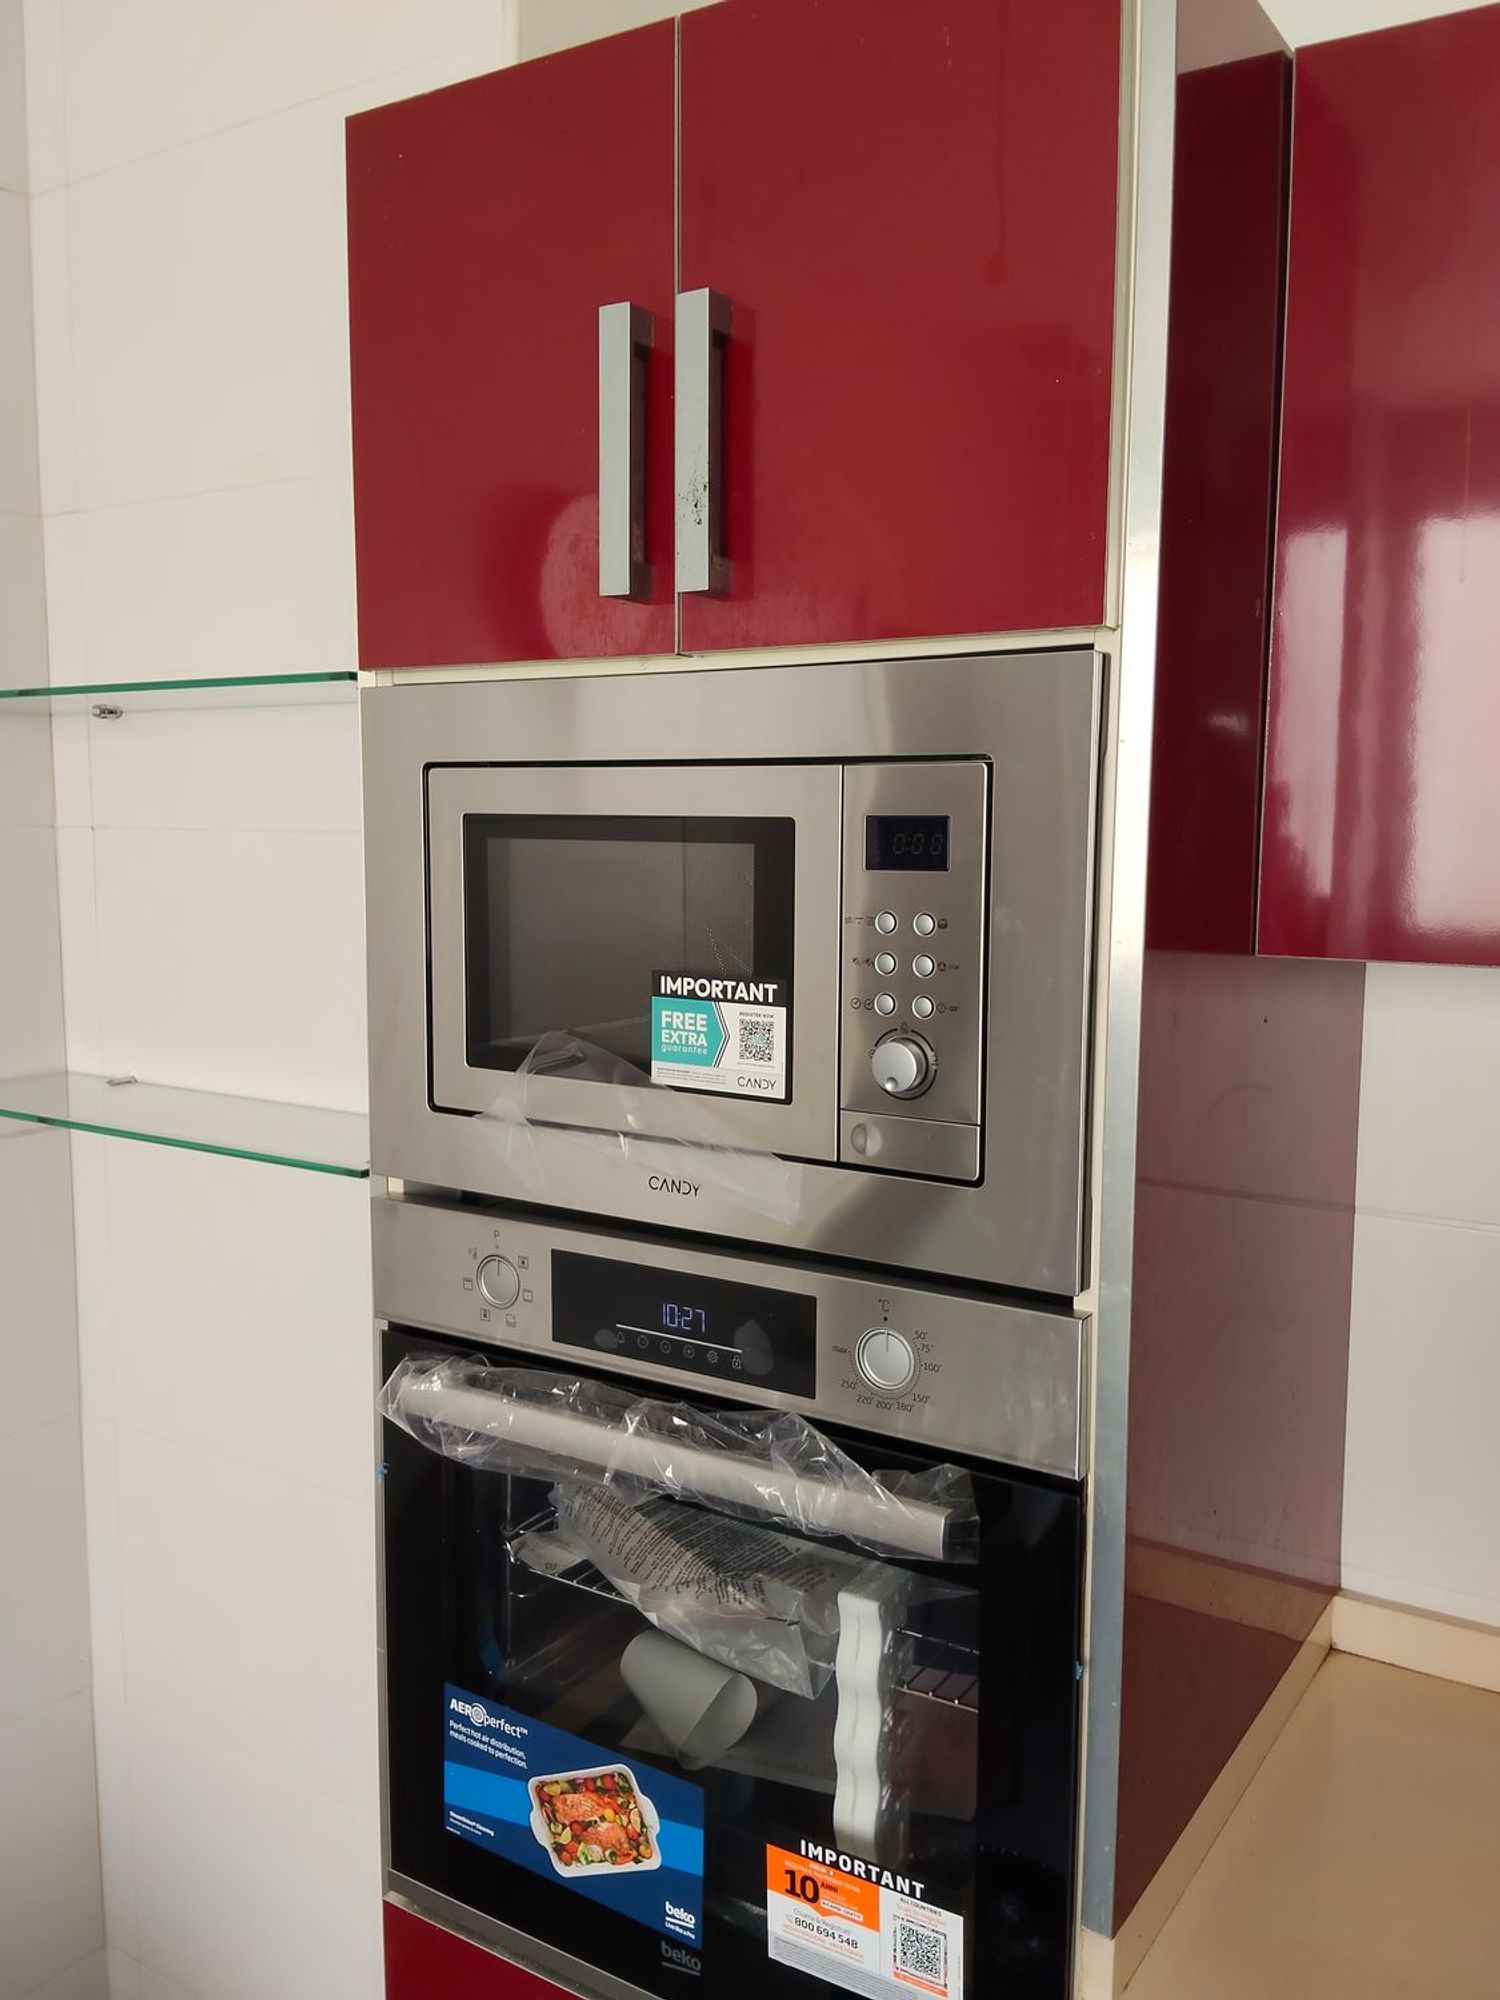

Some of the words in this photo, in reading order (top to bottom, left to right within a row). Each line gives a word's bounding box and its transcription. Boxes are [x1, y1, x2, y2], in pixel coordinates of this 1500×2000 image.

[660, 975, 778, 1003] IMPORTANT
[661, 1010, 708, 1032] FREE
[661, 1030, 708, 1047] EXTRA
[661, 1043, 708, 1055] guarantee
[737, 1076, 777, 1091] CANDY
[648, 1175, 701, 1197] CANDY
[493, 1229, 500, 1240] P
[878, 1299, 890, 1313] °C
[662, 1303, 705, 1333] 10:27
[832, 1345, 848, 1353] max
[449, 1719, 471, 1735] Perfect
[470, 1728, 482, 1740] hot
[482, 1734, 490, 1743] air
[449, 1730, 467, 1743] meals
[466, 1737, 488, 1752] cooked
[488, 1746, 495, 1755] to
[494, 1750, 528, 1770] perfection.
[800, 1839, 926, 1900] IMPORTANT
[785, 1869, 819, 1904] 10
[820, 1880, 839, 1893] ANNI
[665, 1900, 696, 1924] beko
[900, 1897, 910, 1906] ALL
[909, 1900, 943, 1918] COUNTRIES
[794, 1916, 815, 1932] 800
[816, 1925, 836, 1940] 694
[838, 1934, 858, 1949] 548
[661, 1939, 702, 1971] beko
